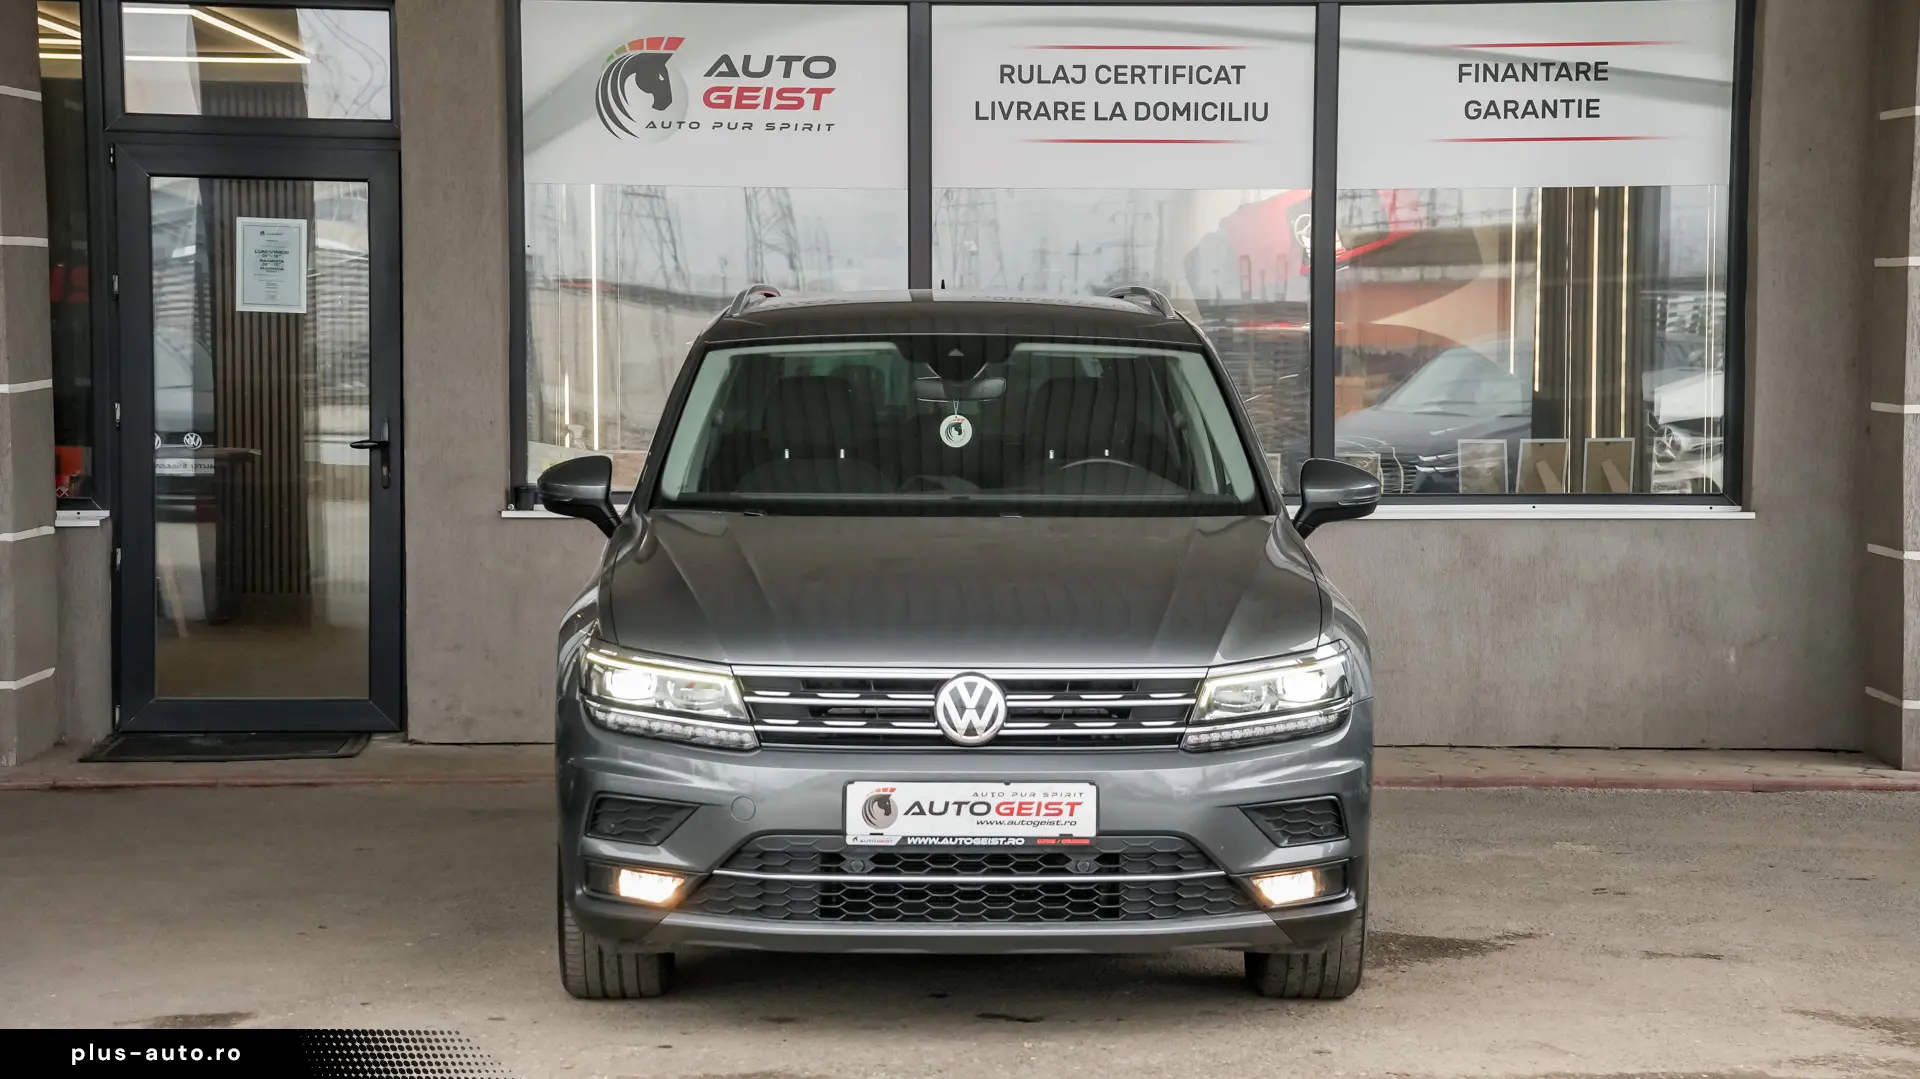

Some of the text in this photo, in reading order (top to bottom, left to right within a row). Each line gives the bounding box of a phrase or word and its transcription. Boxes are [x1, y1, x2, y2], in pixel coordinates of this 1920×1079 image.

[703, 54, 837, 79] AUTO
[999, 64, 1247, 85] RULAJ CERTIFICAT
[1458, 61, 1609, 83] FINANTARE
[702, 86, 836, 111] GEIST
[975, 101, 1269, 122] LIVRARE LA DOMICILIU
[1465, 98, 1601, 121] GARANTIE
[645, 120, 835, 132] AUTO PUR SPIRIT
[976, 818, 1078, 828] www.autogeist.ro
[906, 836, 1026, 846] WWW.AUTOGEIST.RO
